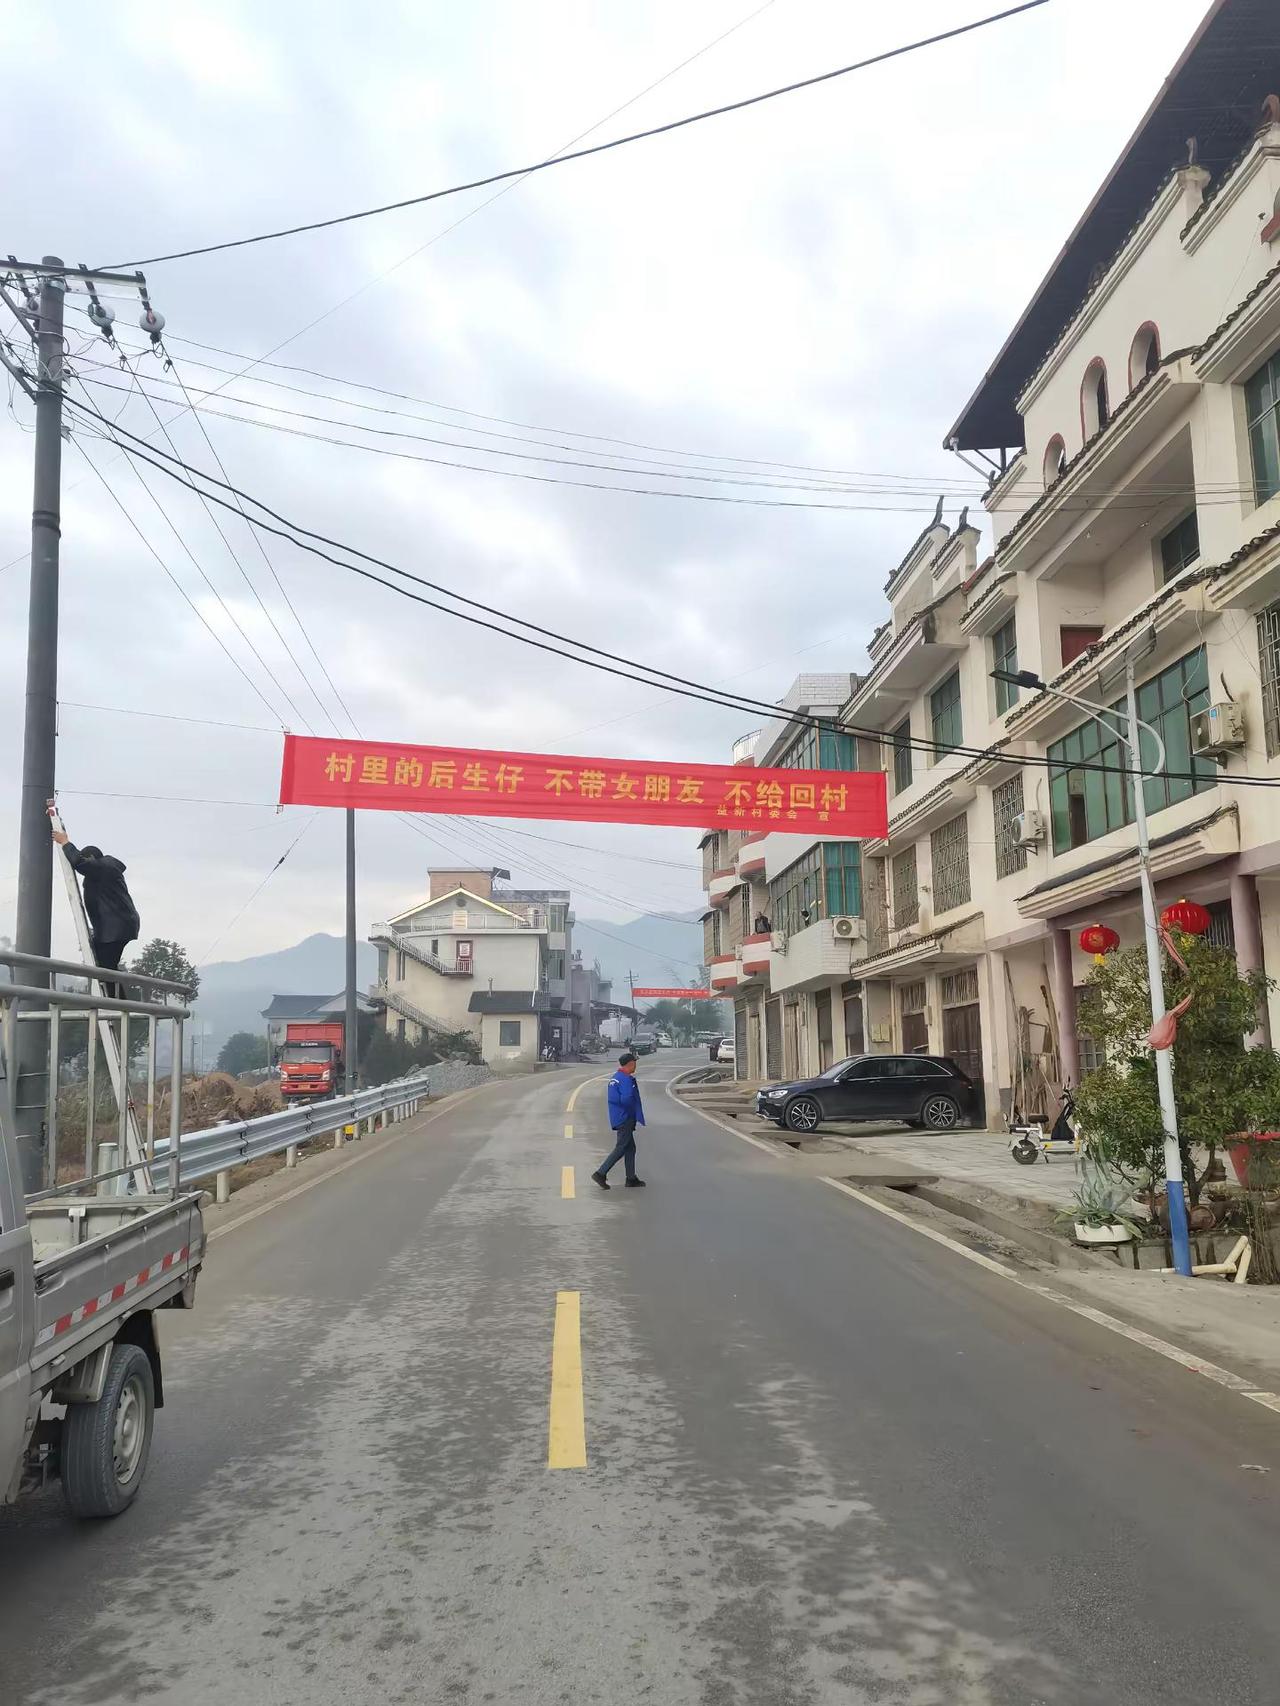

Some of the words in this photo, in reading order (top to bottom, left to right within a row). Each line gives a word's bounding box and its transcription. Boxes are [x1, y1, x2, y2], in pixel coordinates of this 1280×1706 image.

[324, 752, 524, 793] 村里的后生仔
[544, 768, 705, 804] 不带女朋友
[723, 779, 849, 813] 不给回村
